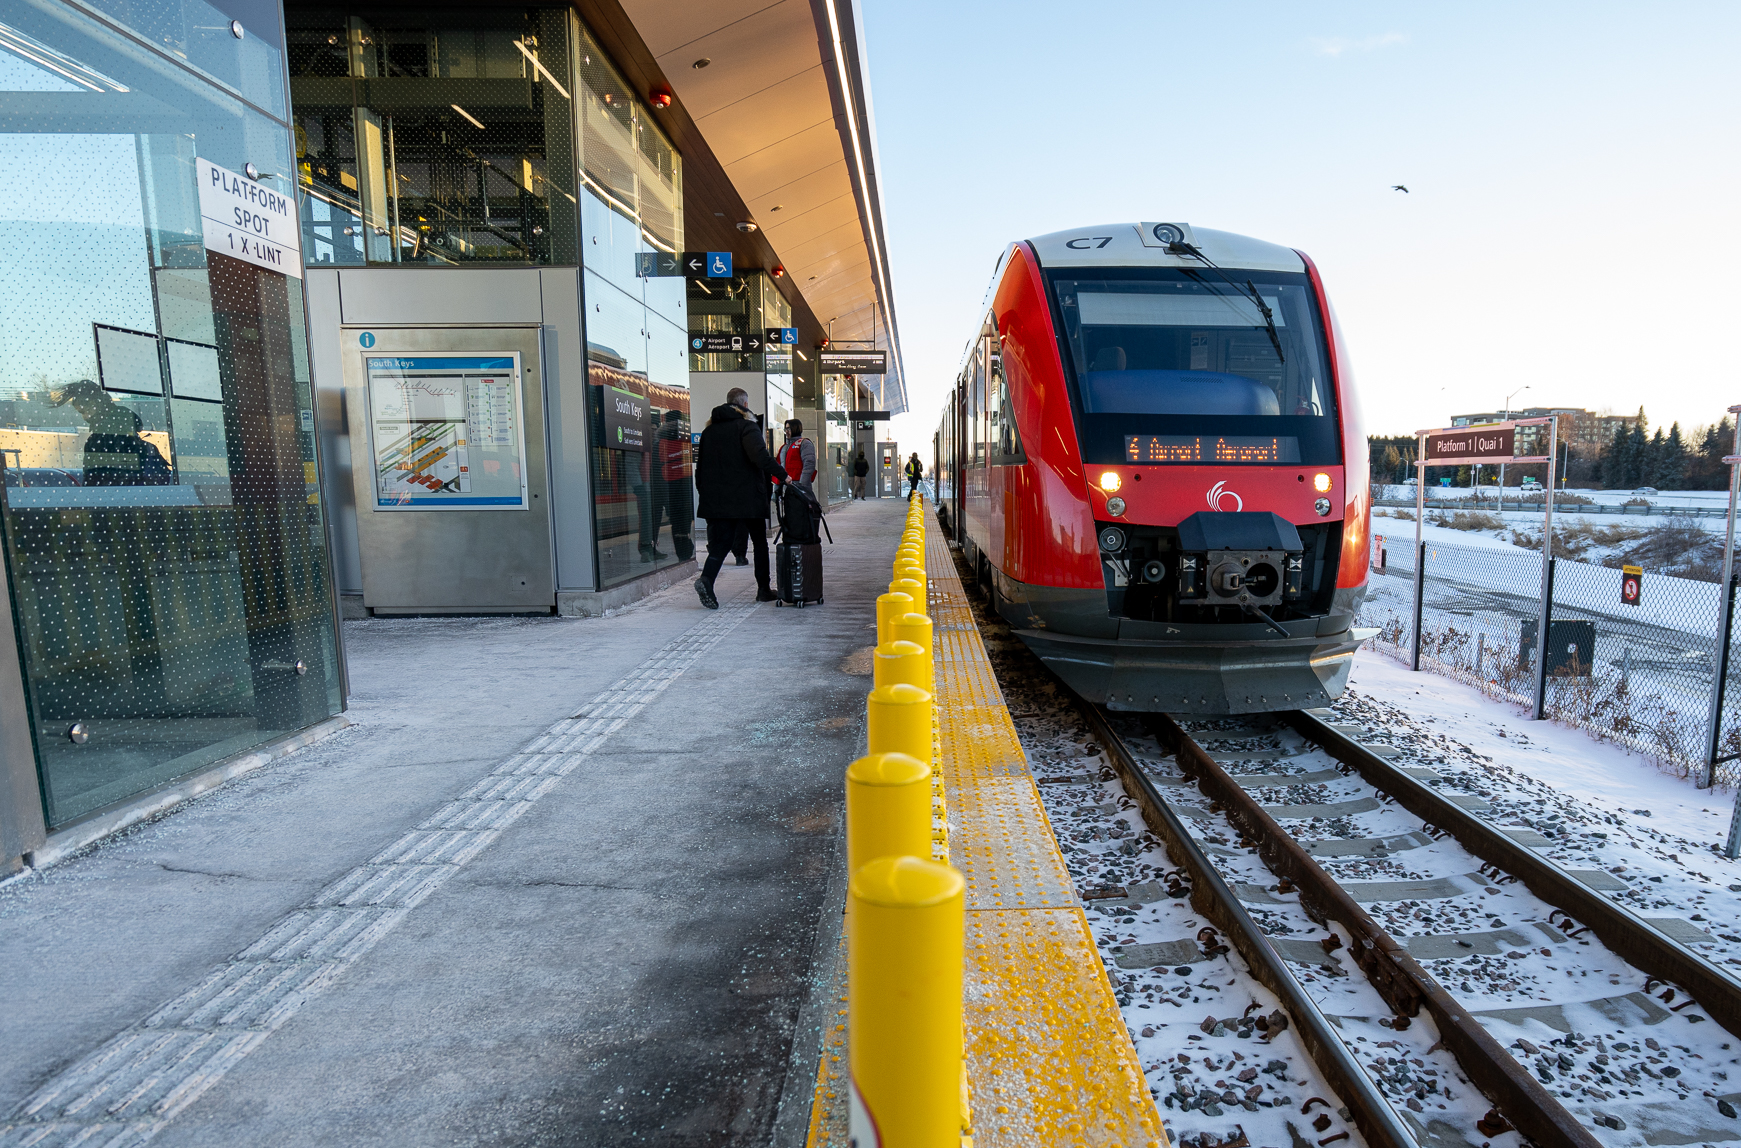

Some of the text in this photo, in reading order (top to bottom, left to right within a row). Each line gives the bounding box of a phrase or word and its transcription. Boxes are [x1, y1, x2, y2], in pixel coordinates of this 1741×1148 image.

[211, 167, 287, 217] PLATFORM
[234, 206, 270, 236] SPOT
[227, 232, 282, 266] 1 X LINT
[1065, 236, 1113, 250] C7
[368, 359, 415, 369] South Keys
[615, 397, 642, 421] South Keys
[1437, 437, 1503, 453] Platform 1 Quai 1
